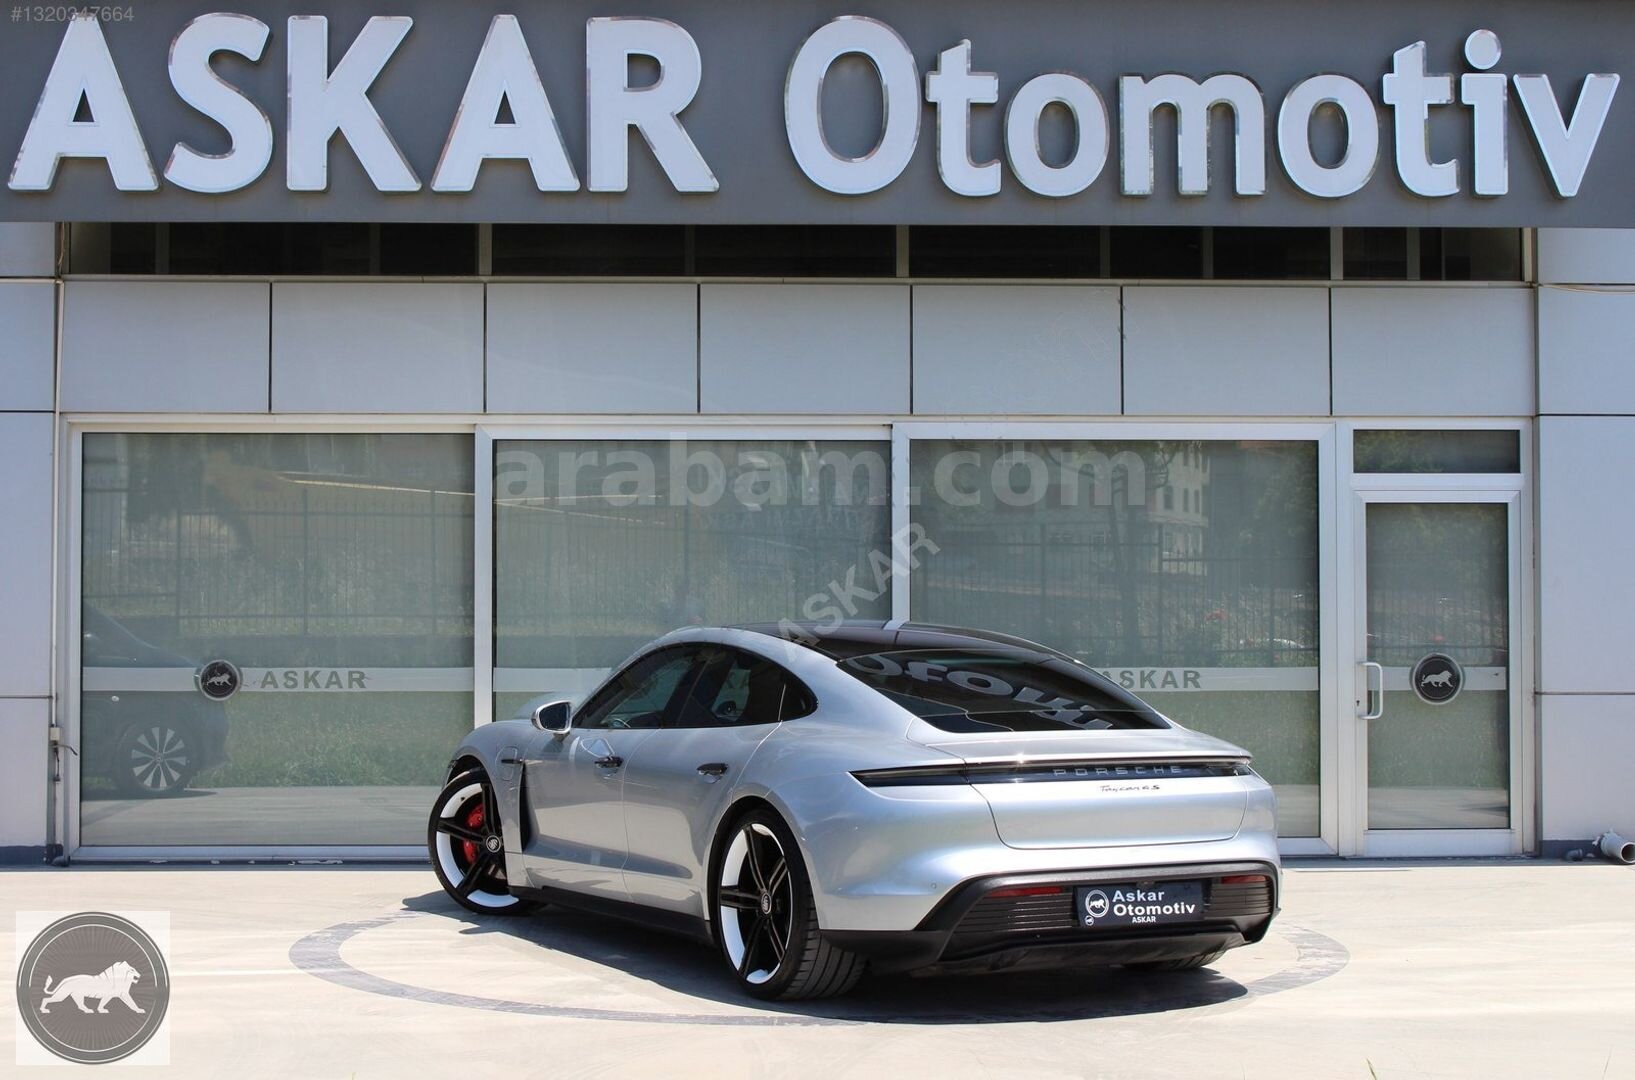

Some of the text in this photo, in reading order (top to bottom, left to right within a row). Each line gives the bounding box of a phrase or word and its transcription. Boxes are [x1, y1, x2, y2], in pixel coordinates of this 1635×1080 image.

[7, 11, 1620, 198] ASKAR Otomotiv
[260, 670, 367, 689] ASKAR
[1053, 765, 1181, 776] PORSCHE
[1112, 890, 1165, 902] Askar
[1113, 901, 1196, 916] Otomotiv
[1132, 915, 1157, 924] ASKAR
